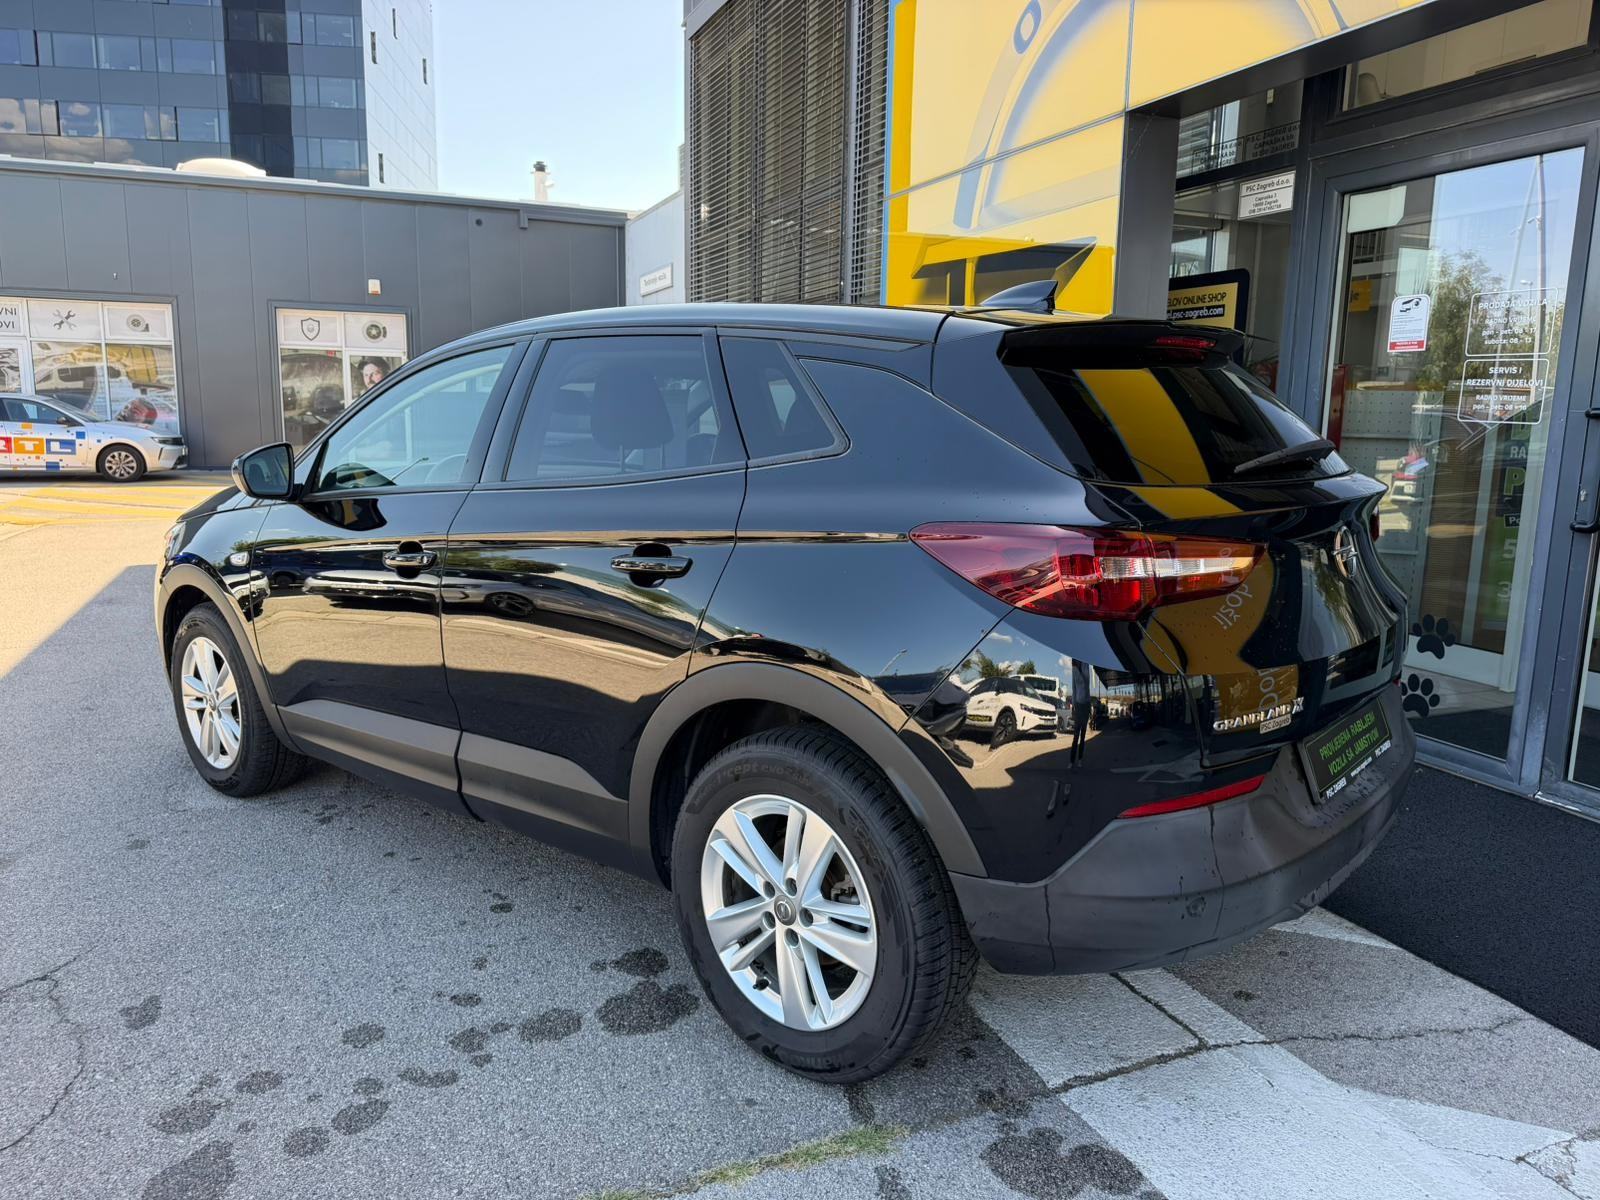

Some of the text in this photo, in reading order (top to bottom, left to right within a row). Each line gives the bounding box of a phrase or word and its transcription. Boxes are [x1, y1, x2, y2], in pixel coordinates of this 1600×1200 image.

[1246, 184, 1256, 192] PSC
[1256, 179, 1275, 191] Zagreb
[1183, 294, 1207, 305] ONLINE
[1208, 291, 1227, 302] SHOP
[1488, 366, 1518, 374] SERVIS
[1466, 378, 1544, 388] REZERVNI DIJELOVI
[1213, 696, 1304, 731] GRANDLAND X
[1261, 717, 1290, 731] PSC Zagreb
[1319, 728, 1352, 760] PROVJERENA
[1327, 753, 1348, 776] VOZILA
[1345, 746, 1356, 761] SA
